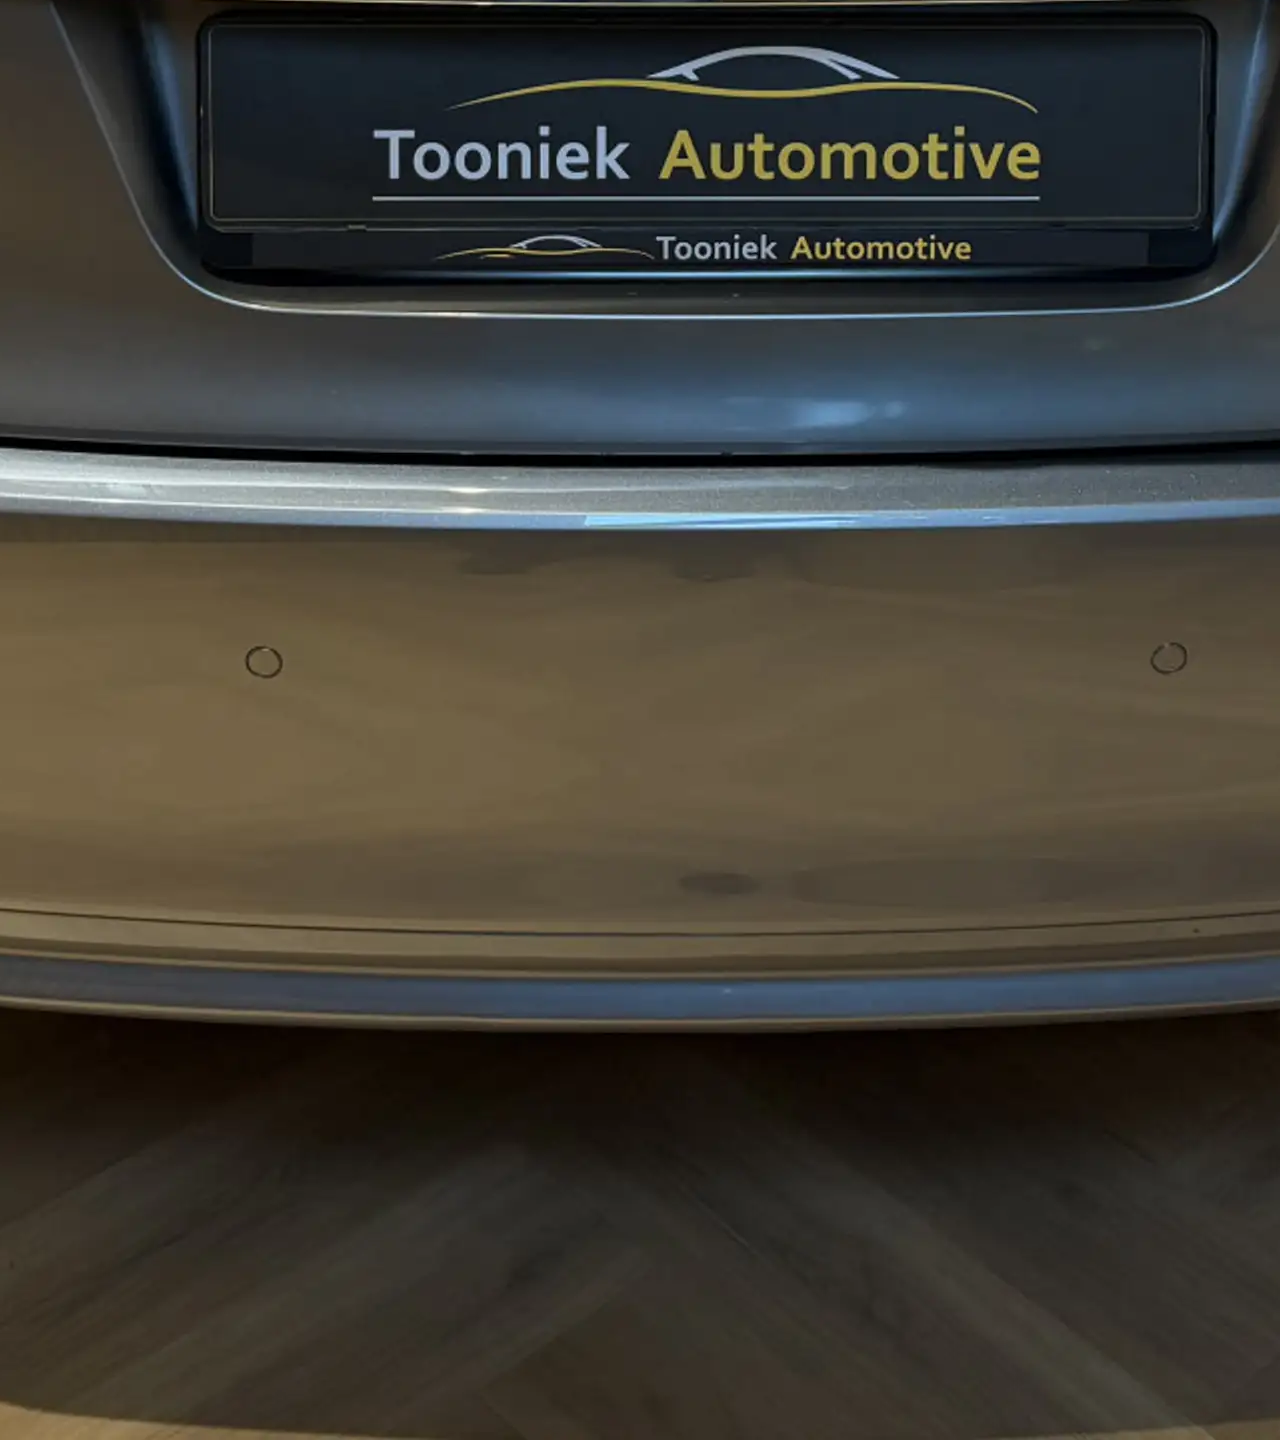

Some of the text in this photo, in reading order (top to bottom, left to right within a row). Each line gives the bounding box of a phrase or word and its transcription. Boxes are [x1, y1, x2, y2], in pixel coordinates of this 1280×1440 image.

[373, 125, 1041, 180] Tooniek Automotive
[655, 234, 972, 260] Tooniek Automotive
